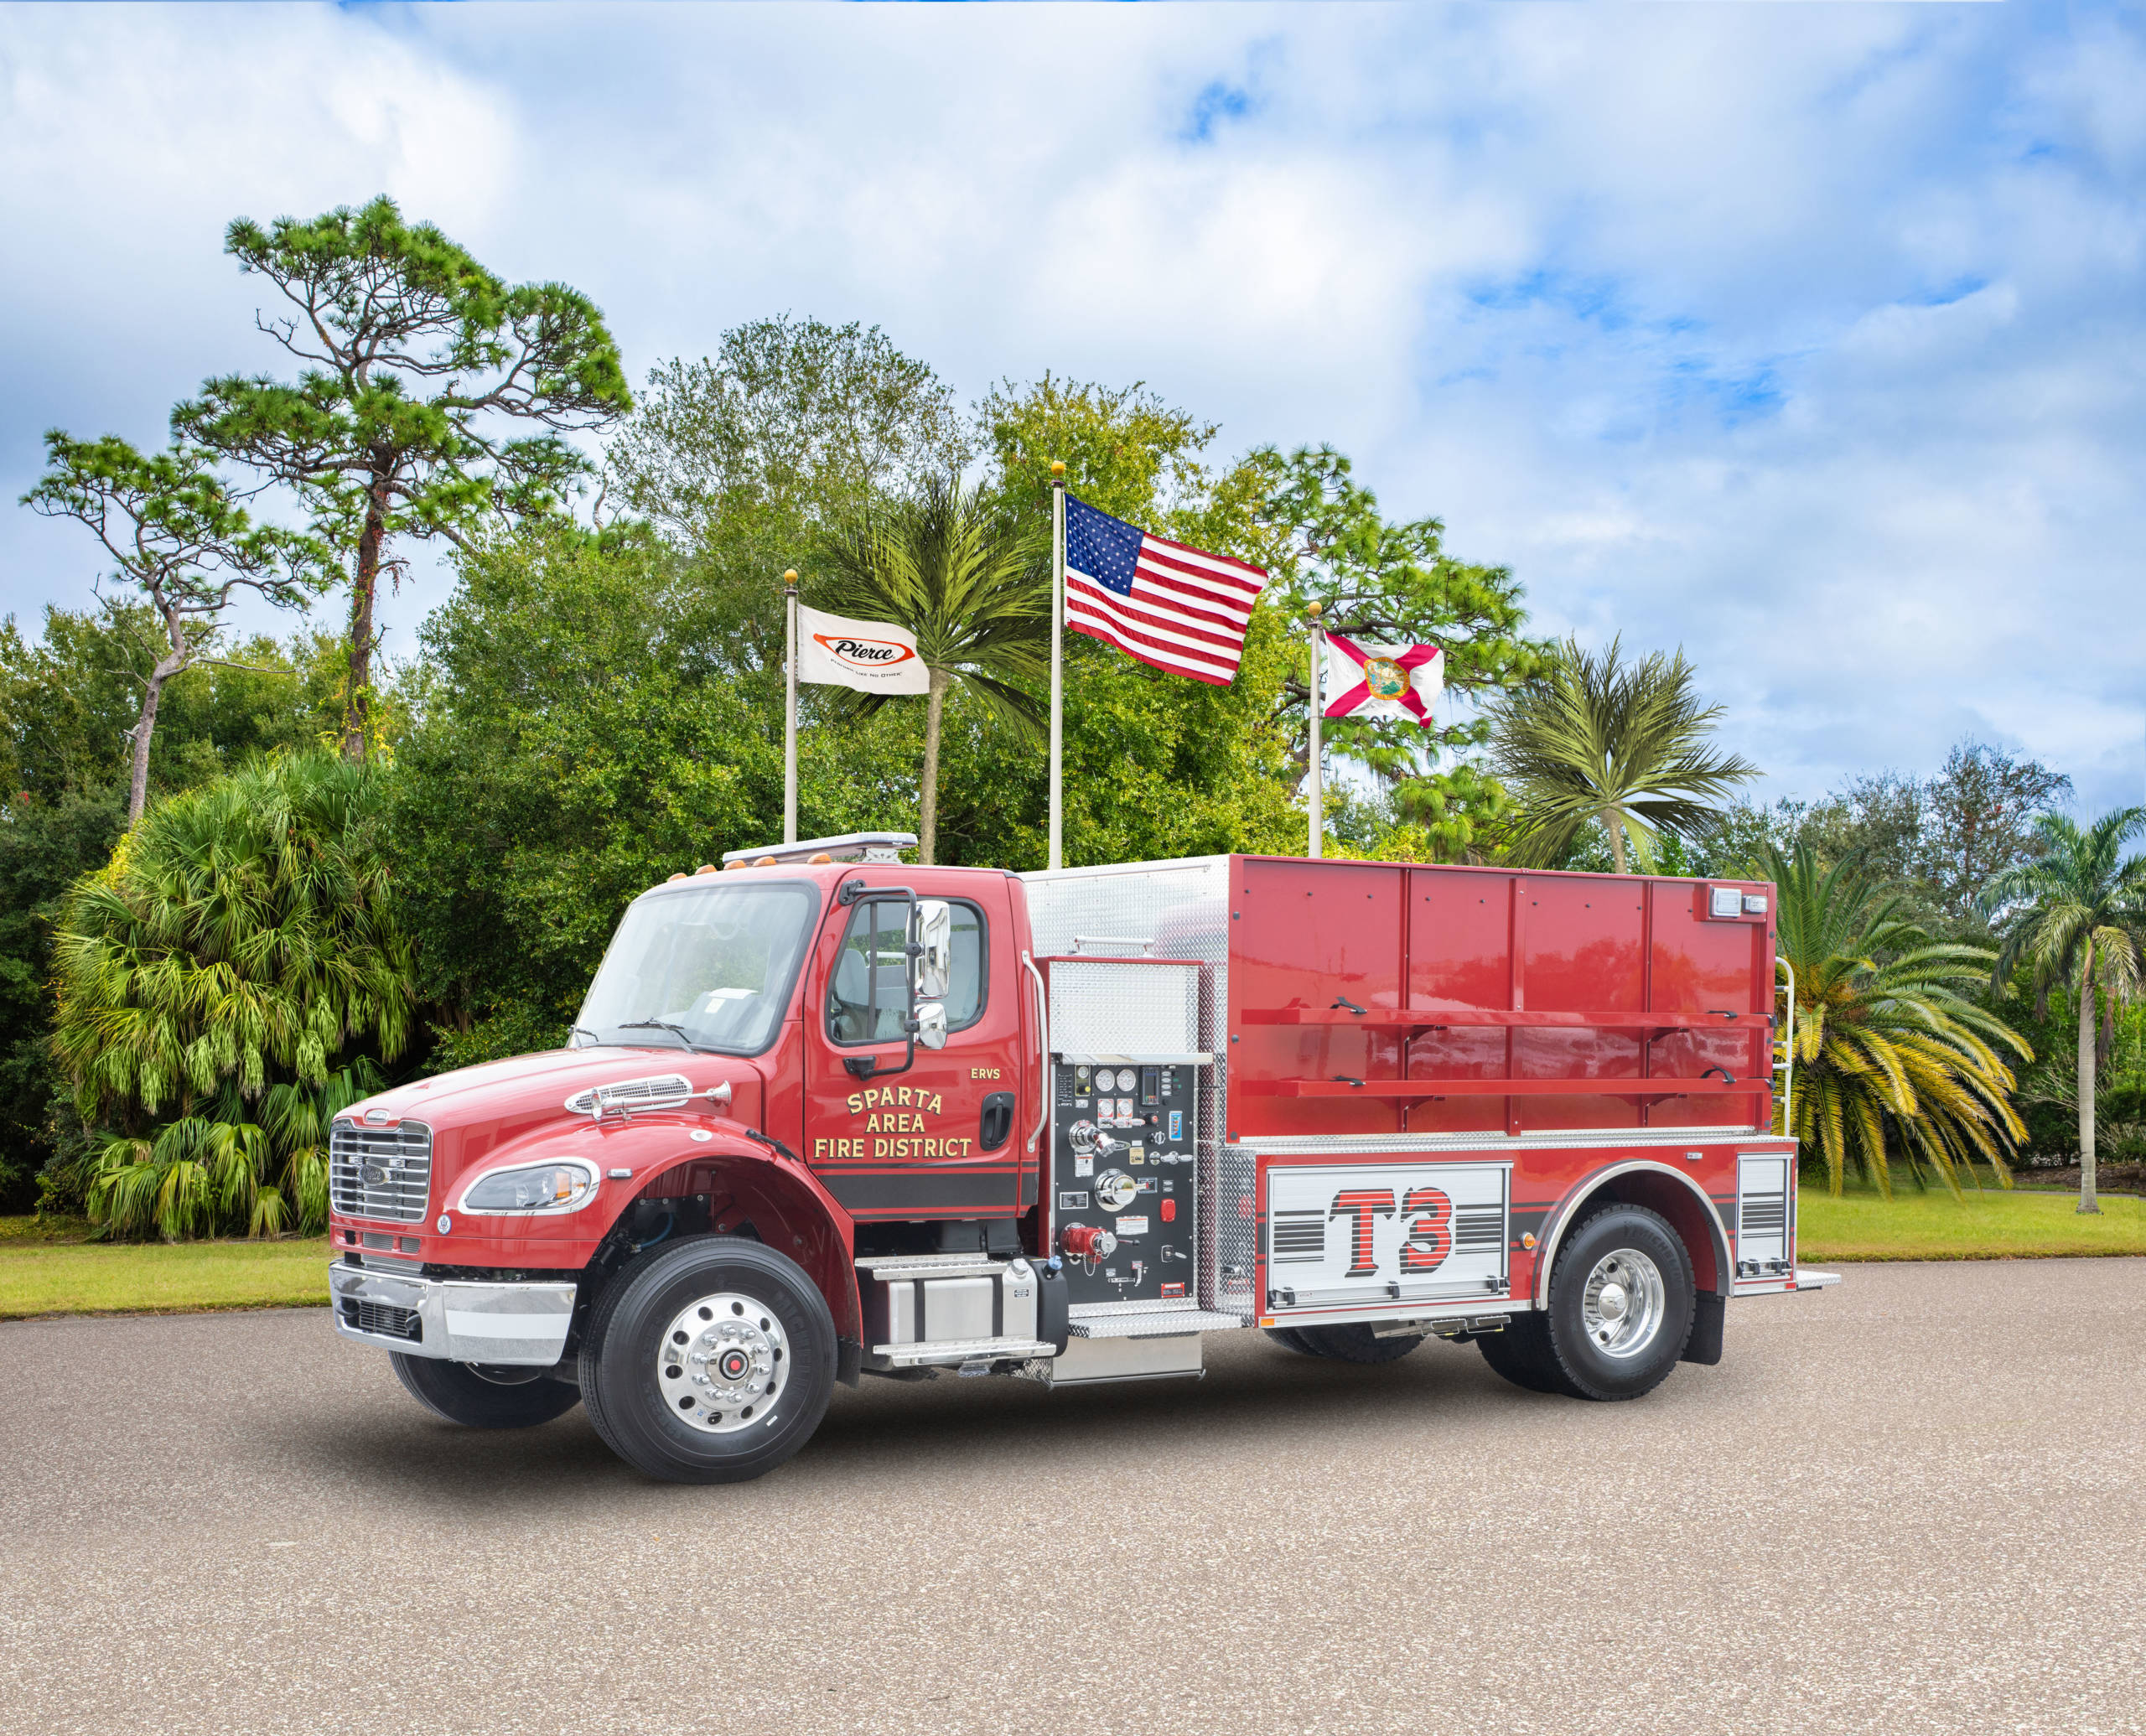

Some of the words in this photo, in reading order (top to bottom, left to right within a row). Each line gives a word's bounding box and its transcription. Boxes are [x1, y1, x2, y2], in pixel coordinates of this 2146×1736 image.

[835, 640, 894, 660] Pierce
[971, 1068, 1000, 1080] ERVS
[847, 1086, 941, 1116] SPARTA
[864, 1113, 925, 1133] AREA
[814, 1138, 865, 1158] FIRE
[873, 1137, 972, 1158] DISTRICT
[1329, 1187, 1453, 1278] T3
